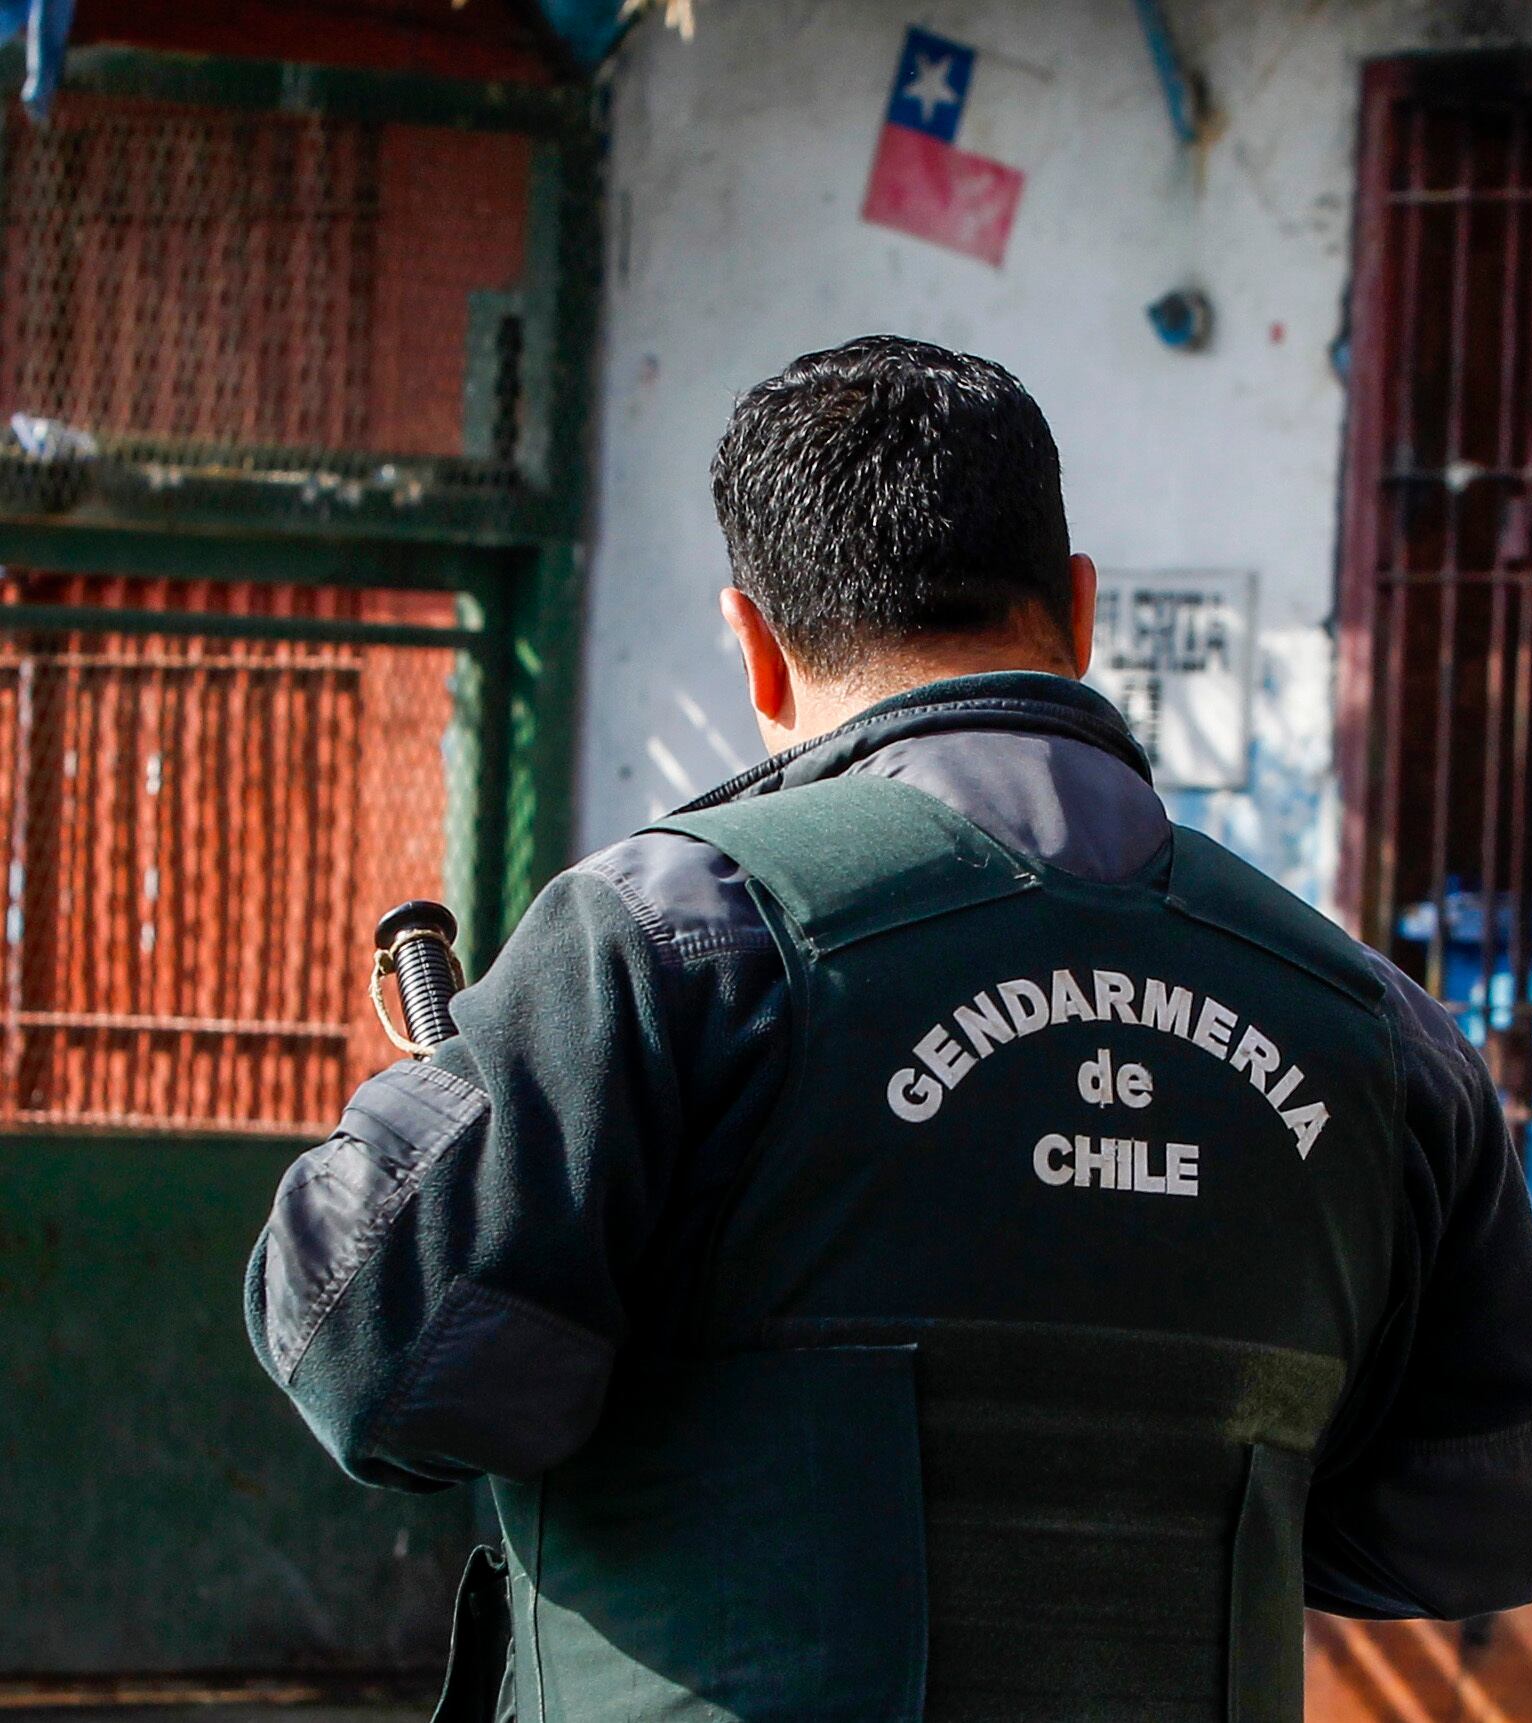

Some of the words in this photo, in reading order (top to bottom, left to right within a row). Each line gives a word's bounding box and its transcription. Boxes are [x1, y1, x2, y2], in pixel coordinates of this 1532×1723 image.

[887, 968, 1331, 1161] GENDARMERIA
[1077, 1047, 1154, 1109] de
[1032, 1133, 1199, 1197] CHILE
